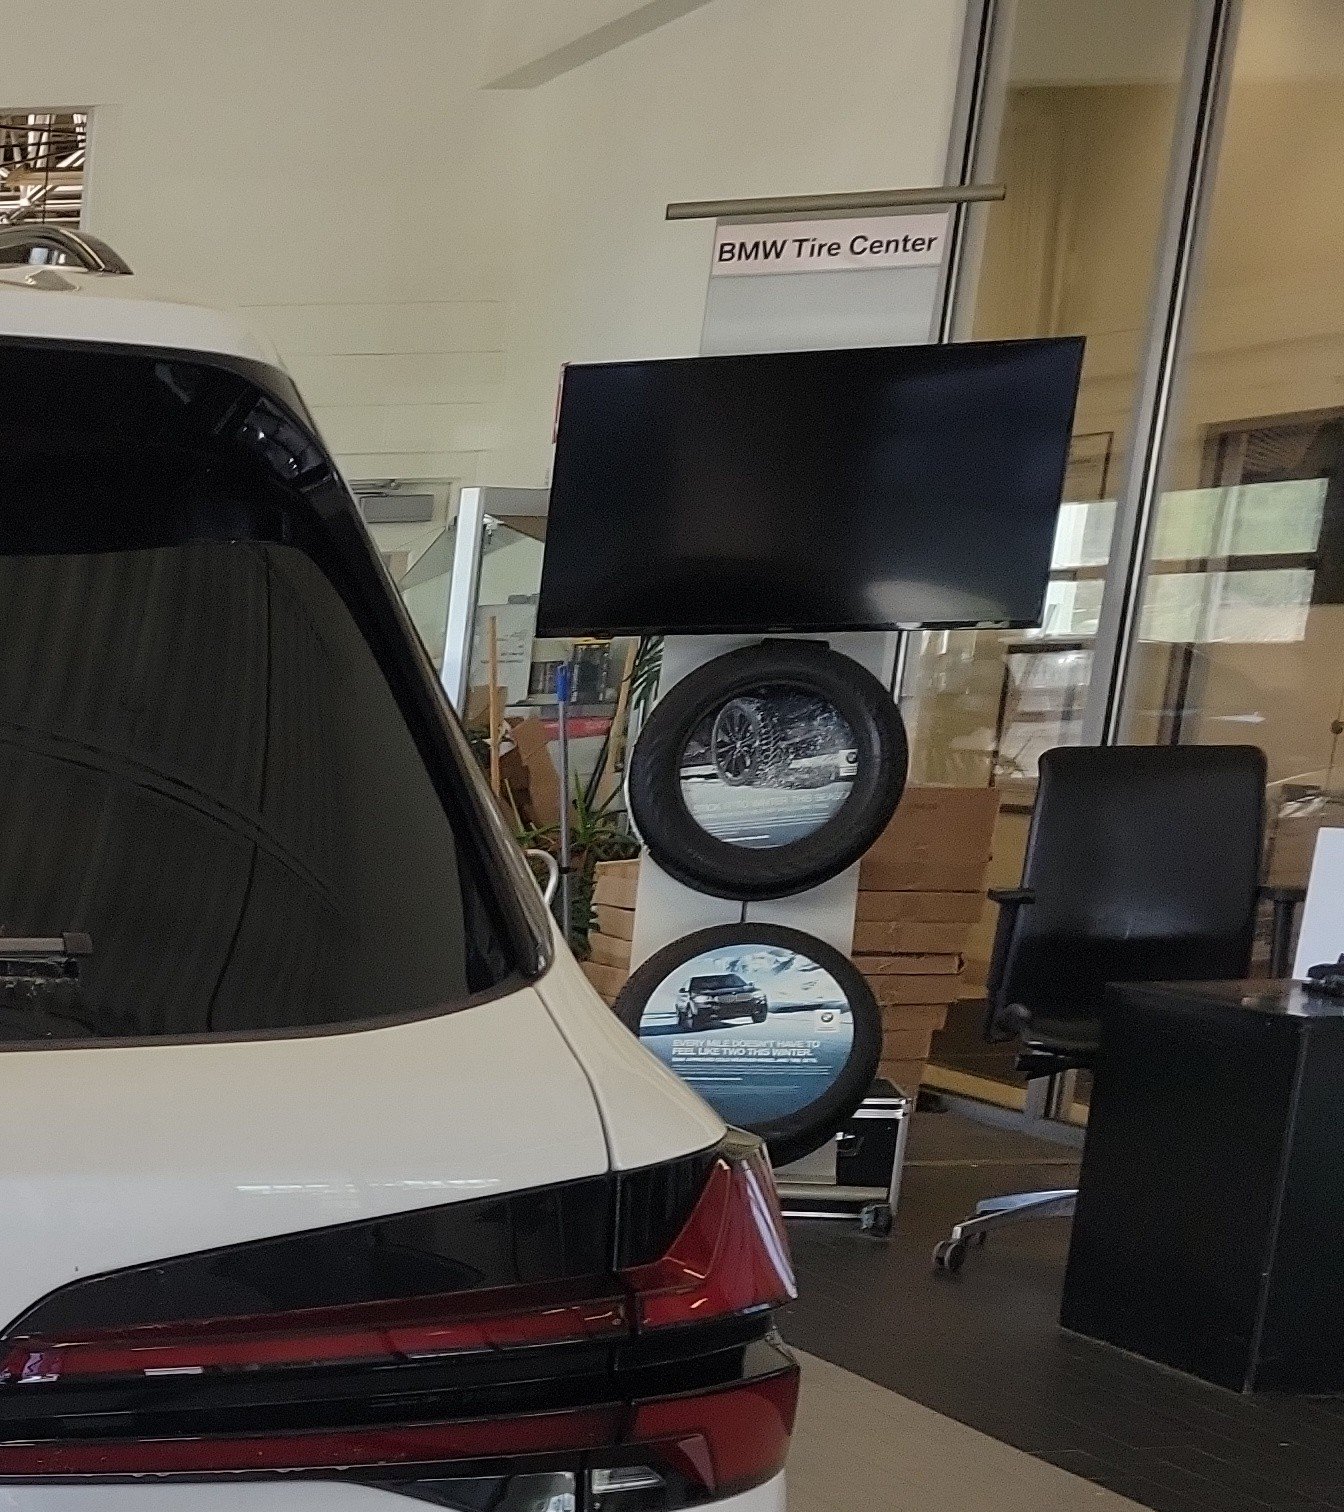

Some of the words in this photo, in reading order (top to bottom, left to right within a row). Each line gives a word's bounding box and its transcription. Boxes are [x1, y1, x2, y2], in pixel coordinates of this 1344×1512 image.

[717, 238, 788, 263] BMW
[792, 236, 842, 259] Tire
[849, 233, 940, 256] Center
[672, 1047, 697, 1056] FEEL
[698, 1047, 721, 1056] LIKE
[722, 1047, 745, 1056] TWO
[746, 1047, 771, 1056] THIS
